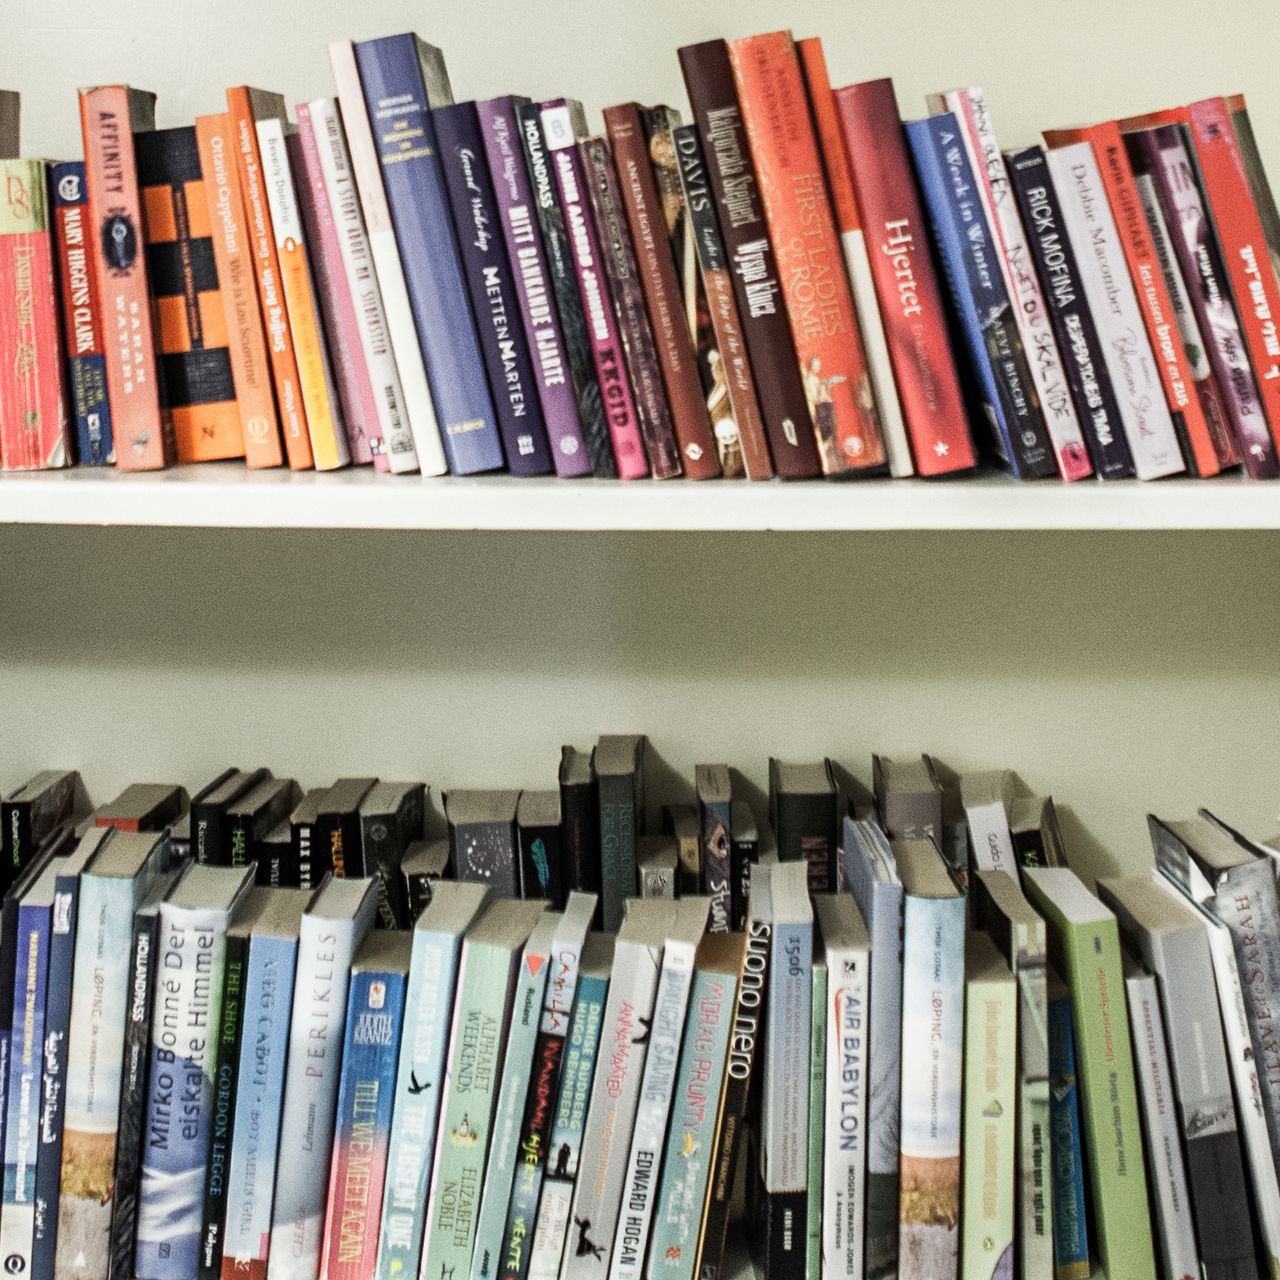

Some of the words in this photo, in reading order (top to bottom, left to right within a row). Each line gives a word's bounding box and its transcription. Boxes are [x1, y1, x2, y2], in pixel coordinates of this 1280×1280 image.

[96, 110, 126, 195] AFFINITY
[207, 134, 230, 185] Ottavio
[266, 136, 283, 177] Beverly
[523, 117, 555, 209] HOLLANDPASS
[937, 127, 955, 147] A
[1103, 144, 1128, 187] Karin
[274, 178, 291, 225] Donofrio
[677, 137, 712, 213] DAVIS
[941, 146, 971, 200] Week
[63, 207, 83, 243] MARY
[213, 185, 241, 254] Cappellani
[337, 186, 359, 222] STORY
[505, 202, 534, 246] MITT
[624, 158, 646, 212] ANCIENT
[637, 212, 655, 251] EGYPT
[789, 171, 824, 240] FIRST
[958, 198, 978, 223] in
[1023, 183, 1056, 233] RICK
[345, 225, 368, 261] ABOUT
[730, 238, 775, 284] Wyspa
[875, 214, 933, 319] Hjertet
[964, 222, 998, 292] Winter
[1069, 161, 1103, 224] Debbie
[1086, 225, 1130, 317] Macomber
[67, 248, 89, 305] HIGGINS
[258, 266, 279, 307] Berlin
[513, 244, 553, 328] BANKANDE
[805, 244, 847, 339] LADIES
[1036, 231, 1077, 307] MOFINA
[700, 225, 720, 259] Light
[715, 293, 733, 321] Edge
[731, 354, 750, 393] World
[744, 278, 783, 319] klucz
[787, 262, 824, 342] ROME
[1143, 284, 1166, 325] tussen
[73, 307, 94, 353] CLARK
[111, 293, 136, 394] WATERS
[126, 298, 148, 384] SARAH
[531, 326, 567, 388] HJARTE
[1154, 321, 1181, 365] broer
[1001, 360, 1031, 420] BINCHY
[1167, 364, 1180, 380] en
[1170, 378, 1191, 408] zus
[1226, 363, 1254, 418] Panda
[164, 923, 186, 971] Der
[737, 921, 773, 1008] suono
[785, 935, 807, 977] 1506
[934, 925, 942, 949] THOR
[1232, 893, 1266, 986] SARAH
[131, 933, 149, 1022] HOLLANDPASS
[185, 925, 216, 1028] Himmel
[226, 960, 242, 996] THE
[257, 958, 280, 1010] MEG
[303, 930, 339, 1079] PERIKLES
[546, 949, 579, 1032] CAMILLA
[655, 967, 687, 1043] DAYLIGHT
[154, 979, 183, 1064] Bonné
[221, 999, 238, 1045] SHOE
[570, 1000, 589, 1046] HUGO
[581, 1001, 601, 1057] DENISE
[614, 1000, 638, 1042] ANNA
[693, 980, 725, 1052] MORAG
[843, 994, 861, 1029] AIR
[1140, 998, 1158, 1057] ESSENTIAL
[248, 1014, 275, 1089] CABOT
[455, 1008, 481, 1095] WEEKENDS
[473, 1014, 496, 1094] ALPHABET
[605, 1042, 631, 1100] MAXTED
[645, 1043, 675, 1104] SAVING
[727, 1015, 758, 1081] nero
[18, 1071, 35, 1111] Leven
[149, 1072, 175, 1150] Mirko
[175, 1036, 208, 1141] eiskalte
[213, 1063, 232, 1138] GORDON
[351, 1078, 381, 1121] TILL
[569, 1059, 592, 1131] RUDBERG
[680, 1056, 714, 1133] PRUNTY
[838, 1036, 862, 1151] BABYLON
[930, 1063, 939, 1138] VERDENSHISTORIE
[347, 1117, 376, 1152] WE
[208, 1142, 225, 1196] LEGGE
[341, 1154, 372, 1206] MEET
[628, 1149, 654, 1212] EDWARD
[846, 1164, 856, 1198] IMOGEN
[437, 1179, 458, 1232] NOBLE
[452, 1165, 477, 1248] ELIZABETH
[833, 1200, 844, 1250] Anonymous
[201, 1222, 217, 1268] Polygon
[335, 1207, 367, 1266] AGAIN
[504, 1215, 527, 1272] VENTE
[618, 1214, 643, 1267] HOGAN
[843, 1199, 856, 1275] EDWARDS-JONES
